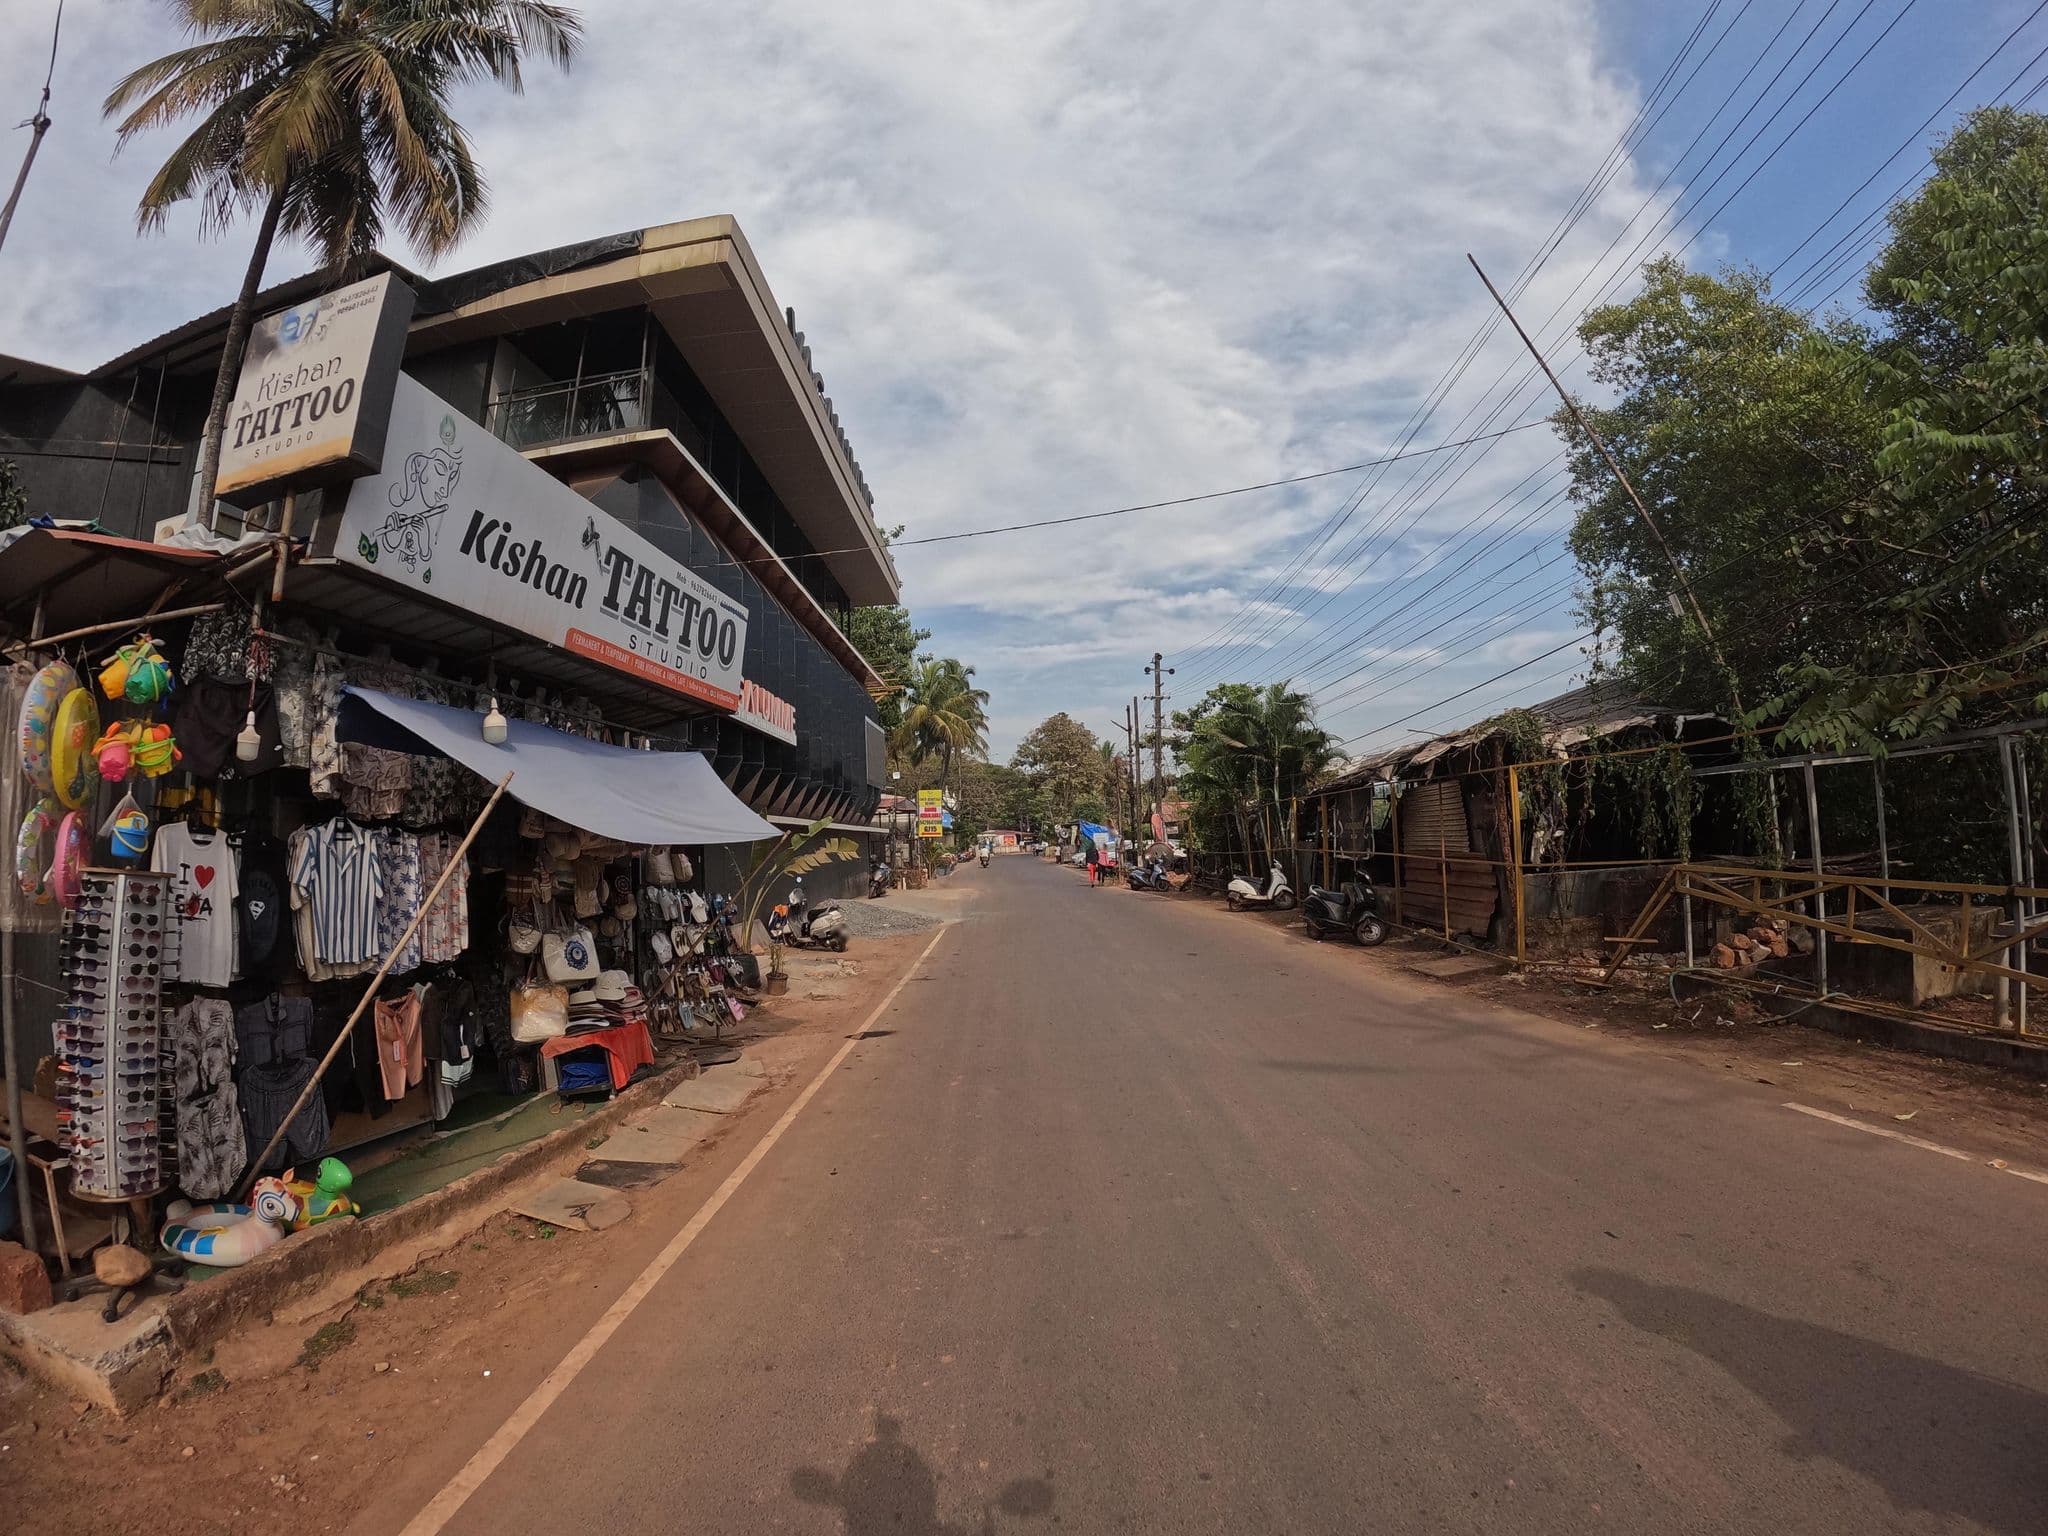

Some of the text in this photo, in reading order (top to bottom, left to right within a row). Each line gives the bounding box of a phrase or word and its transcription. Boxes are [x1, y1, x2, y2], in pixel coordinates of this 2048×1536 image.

[257, 356, 342, 402] Kishan
[233, 377, 355, 450] TATTOO
[254, 430, 314, 458] STUDIO
[459, 509, 588, 610] Kishan
[602, 545, 737, 667] TATTOO
[629, 634, 707, 680] STUDIO
